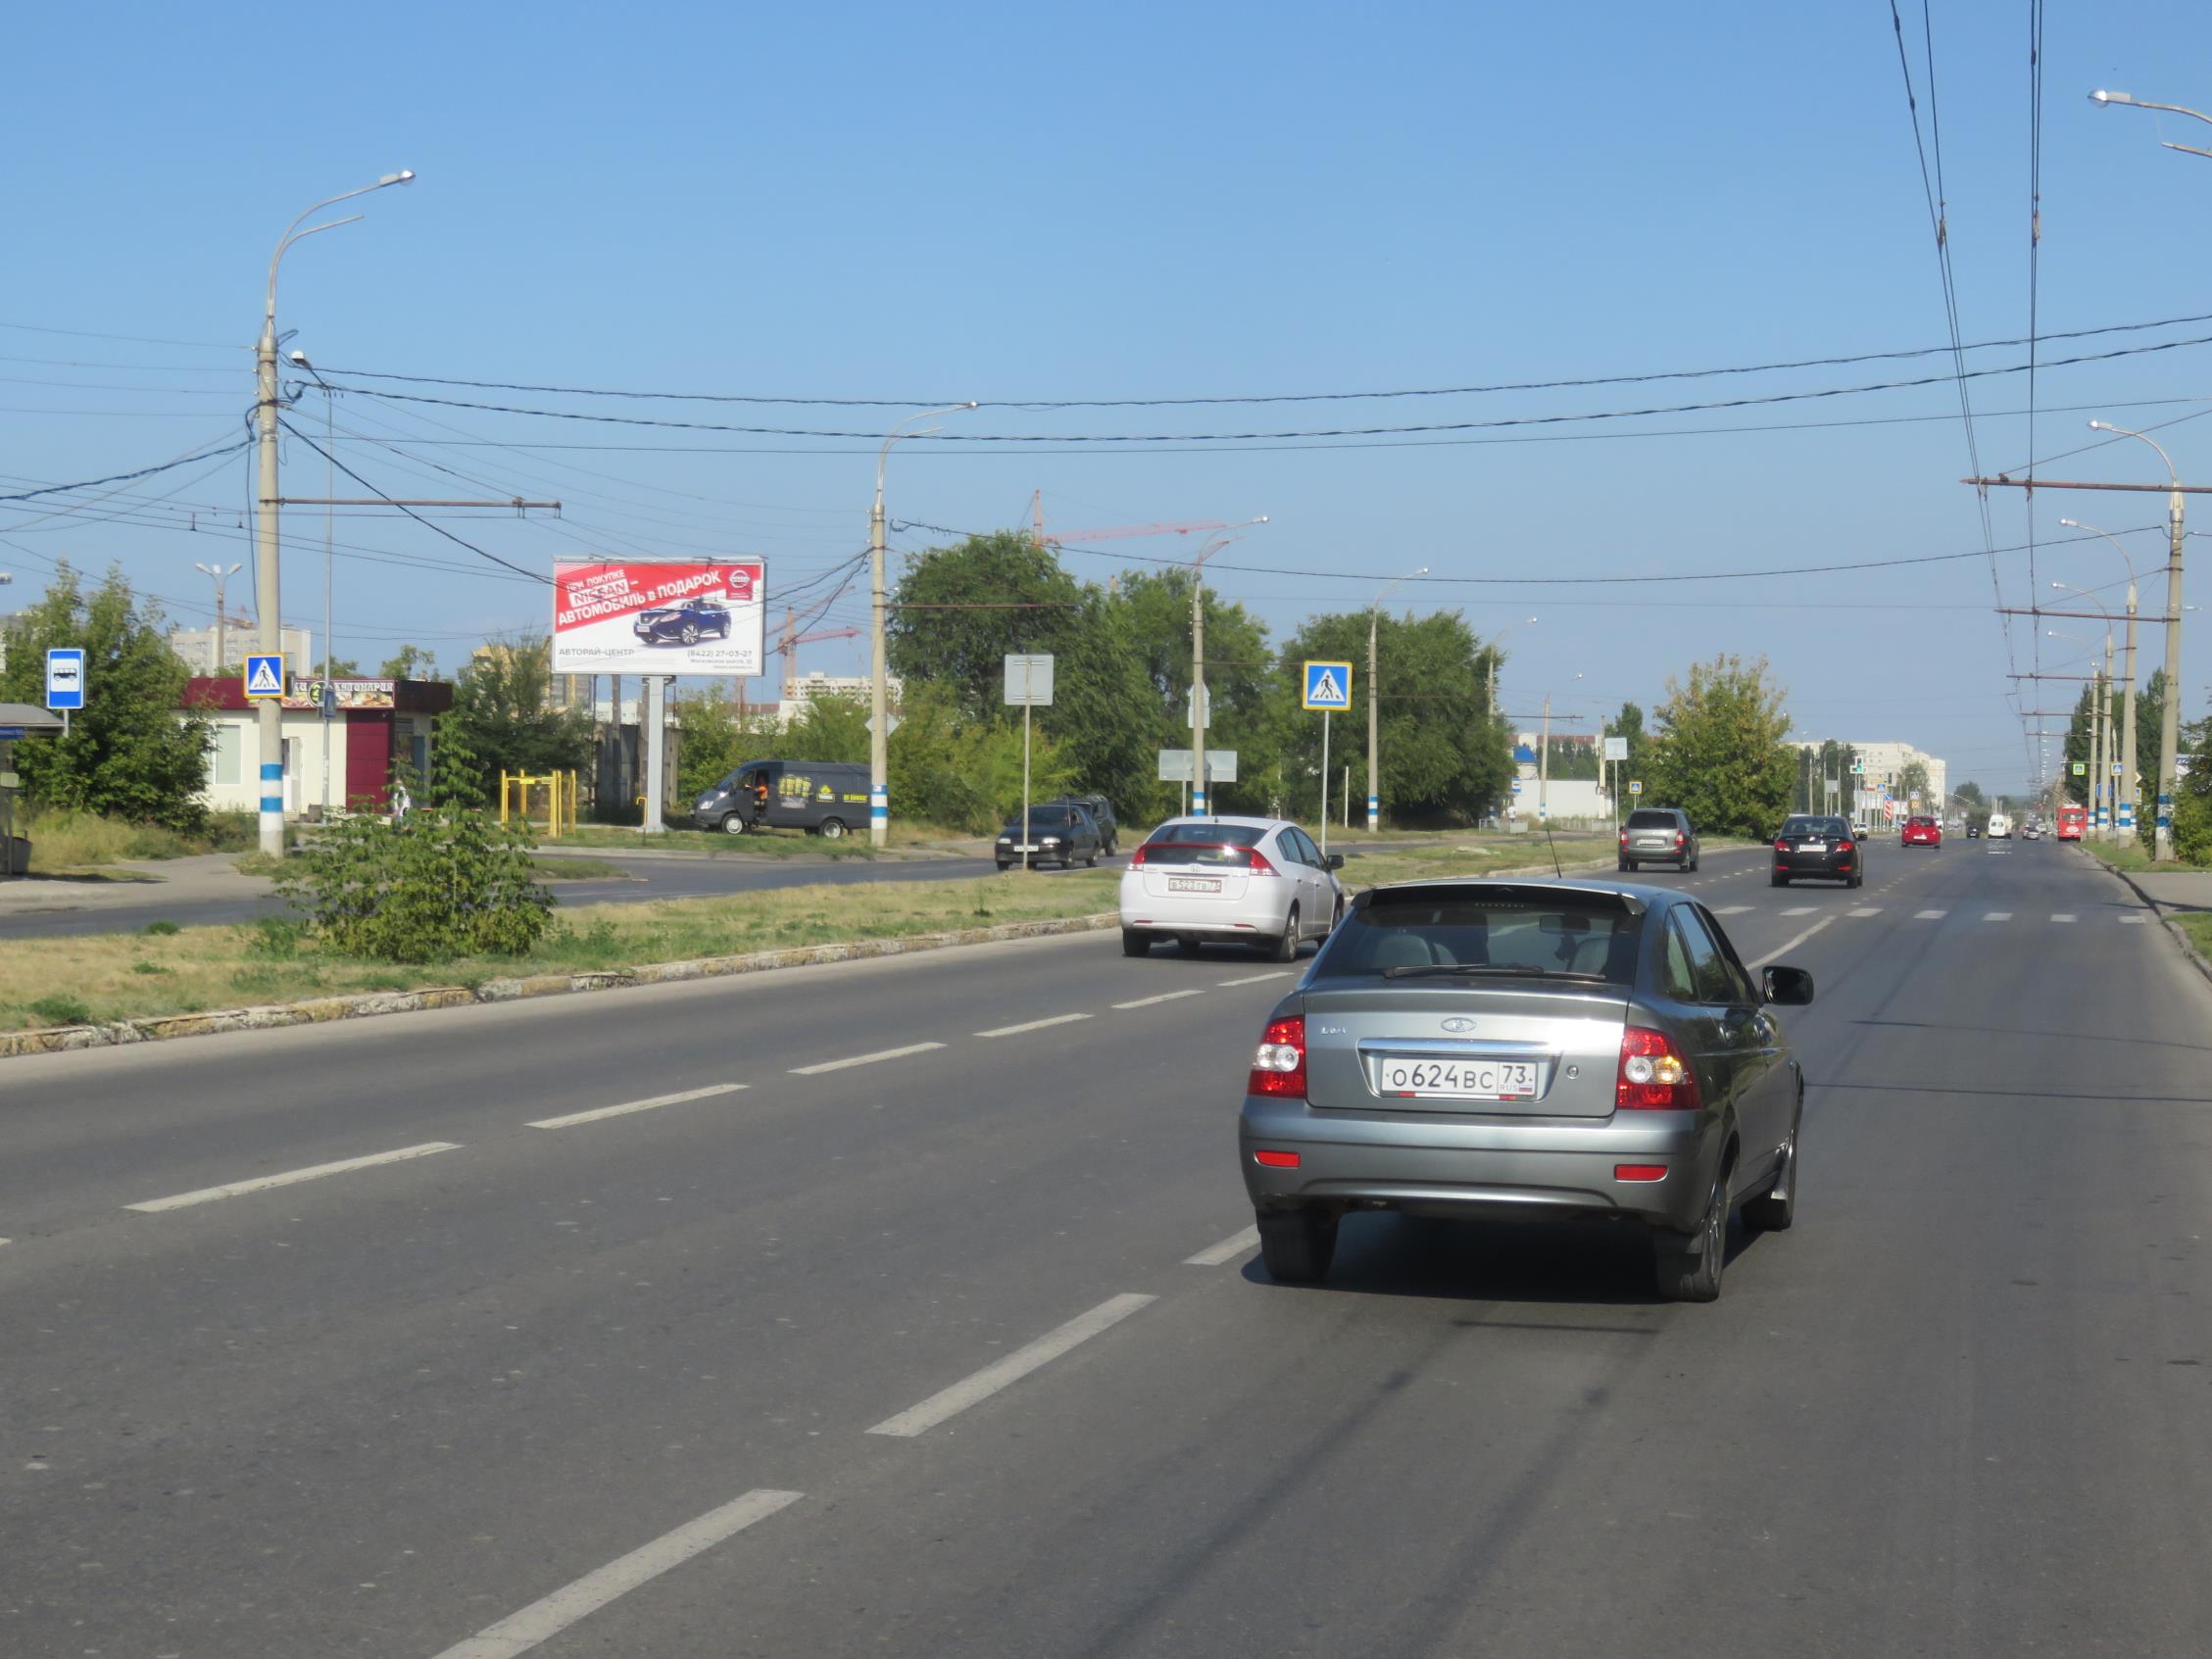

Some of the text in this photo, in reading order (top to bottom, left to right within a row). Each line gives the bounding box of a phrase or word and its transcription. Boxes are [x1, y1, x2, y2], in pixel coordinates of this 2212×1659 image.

[586, 568, 626, 587] ПОКУПКЕ
[558, 592, 647, 626] АВТОМОБИЛЬ
[657, 569, 721, 599] ПОДАРОК
[569, 578, 629, 607] NISSAN
[559, 648, 635, 657] АВТОРАЙ-ЦЕНТР
[1393, 1064, 1526, 1090] О624ВС 73
